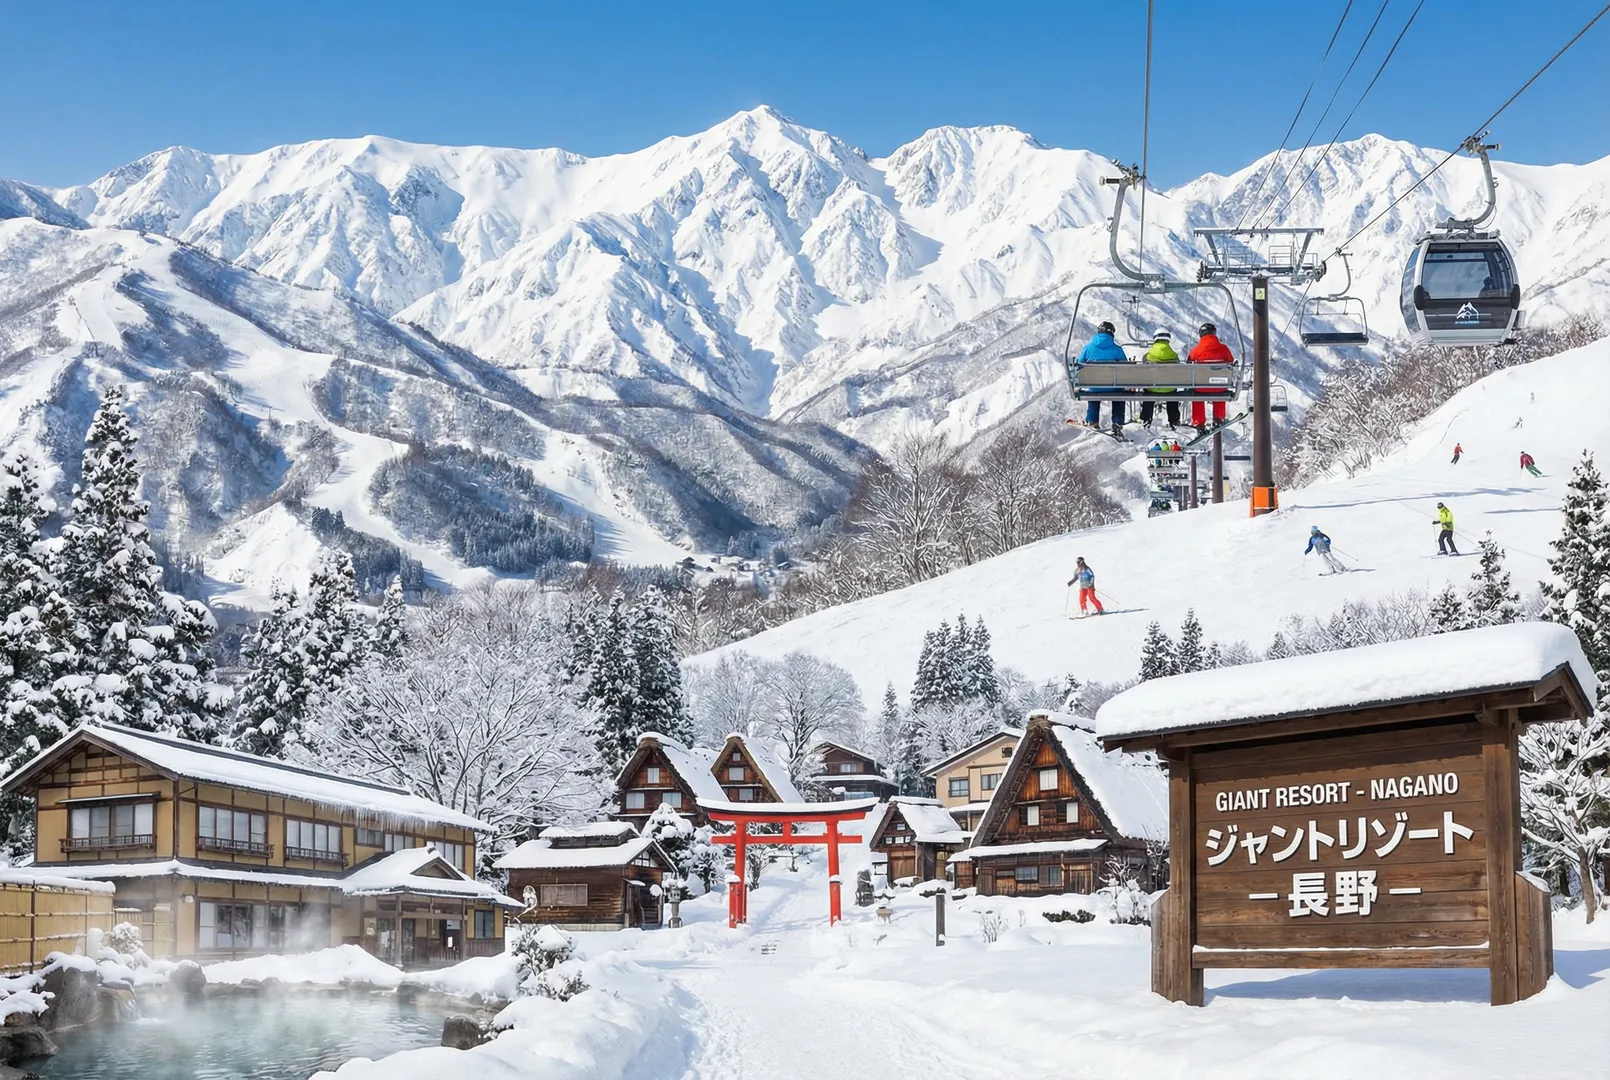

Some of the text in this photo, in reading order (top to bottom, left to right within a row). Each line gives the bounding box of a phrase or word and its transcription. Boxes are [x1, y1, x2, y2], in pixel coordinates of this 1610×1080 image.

[1215, 788, 1271, 812] GIANT
[1275, 782, 1351, 808] RESORT
[1370, 772, 1459, 801] NAGANO
[1205, 811, 1474, 866] ジャントリゾート
[1288, 869, 1379, 918] 長野
